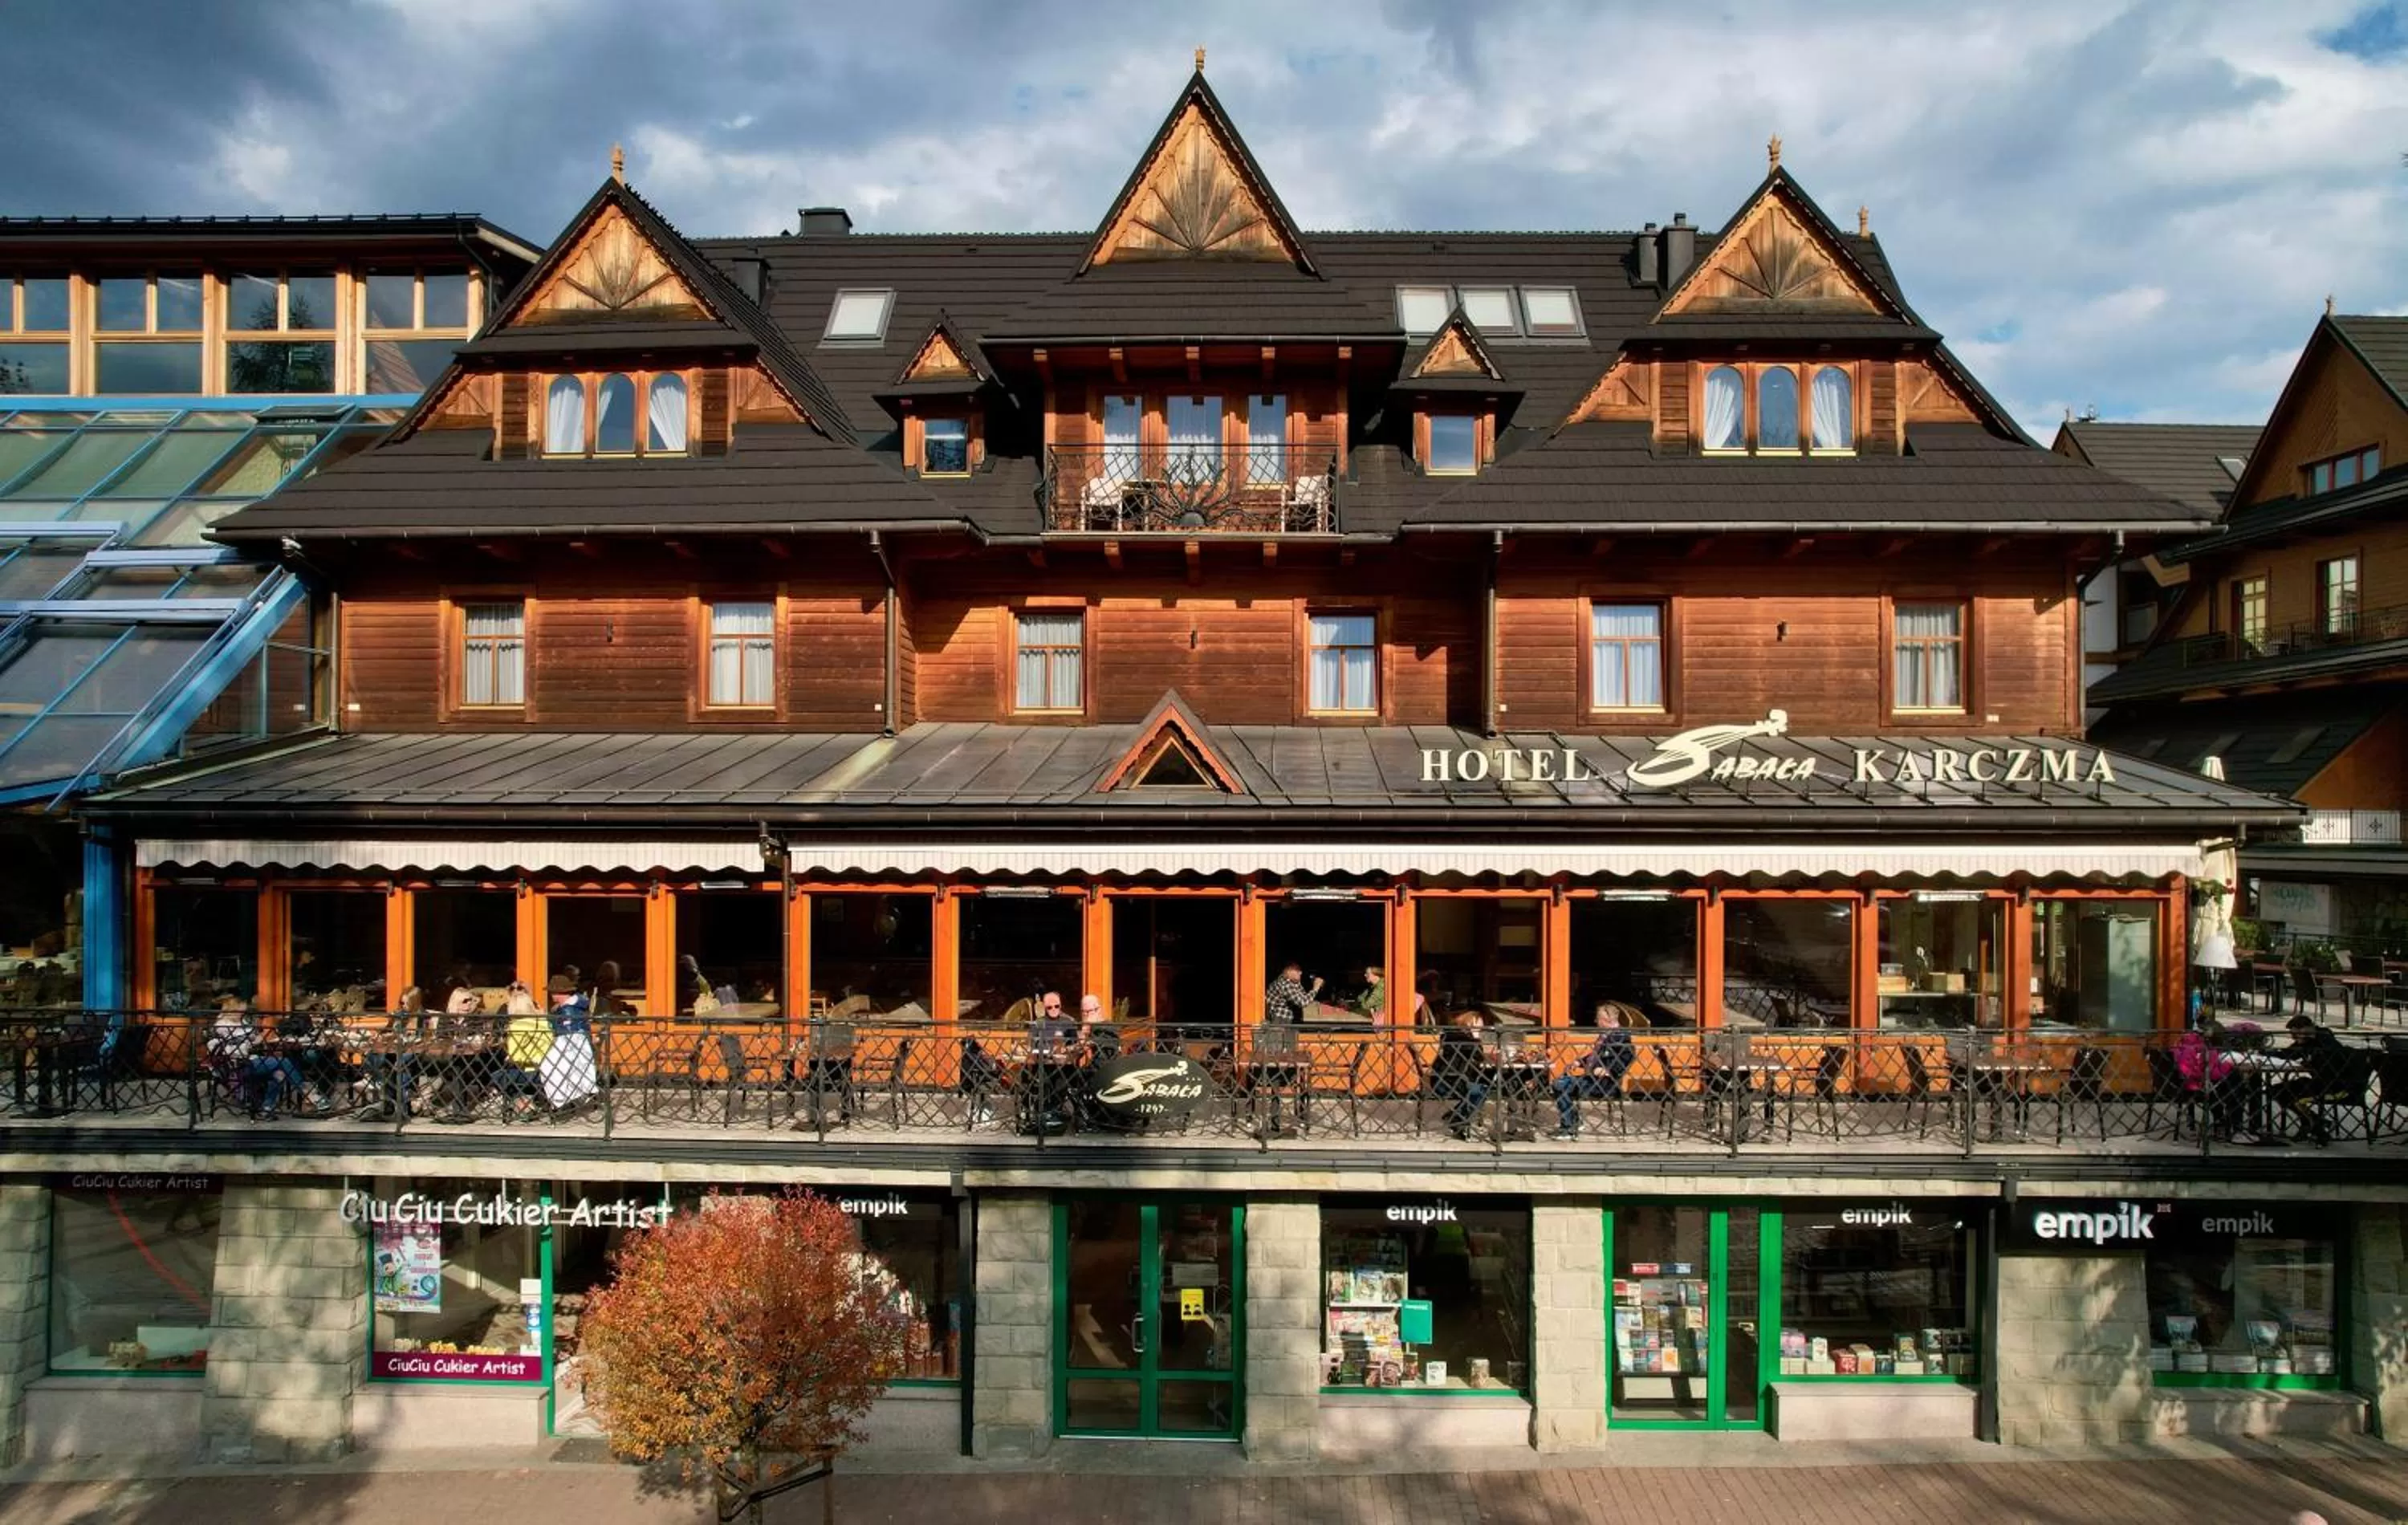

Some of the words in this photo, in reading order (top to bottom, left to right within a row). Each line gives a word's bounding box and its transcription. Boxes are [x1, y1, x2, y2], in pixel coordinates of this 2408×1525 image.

[1420, 748, 1591, 782] HOTEL
[1853, 749, 2116, 783] KARCZMA
[72, 1174, 114, 1188] CiuCiu
[118, 1175, 161, 1189] Cukier
[166, 1176, 209, 1189] Artist
[454, 1192, 559, 1226] Cukier
[569, 1197, 673, 1230] Artist
[840, 1192, 909, 1218] empik
[1386, 1198, 1458, 1225] empik
[1842, 1201, 1914, 1227] empik
[2035, 1202, 2154, 1245] empik
[2202, 1210, 2274, 1236] empik
[388, 1359, 429, 1372] CiuCiu
[433, 1360, 478, 1373] Cukier
[482, 1360, 526, 1375] Artist
